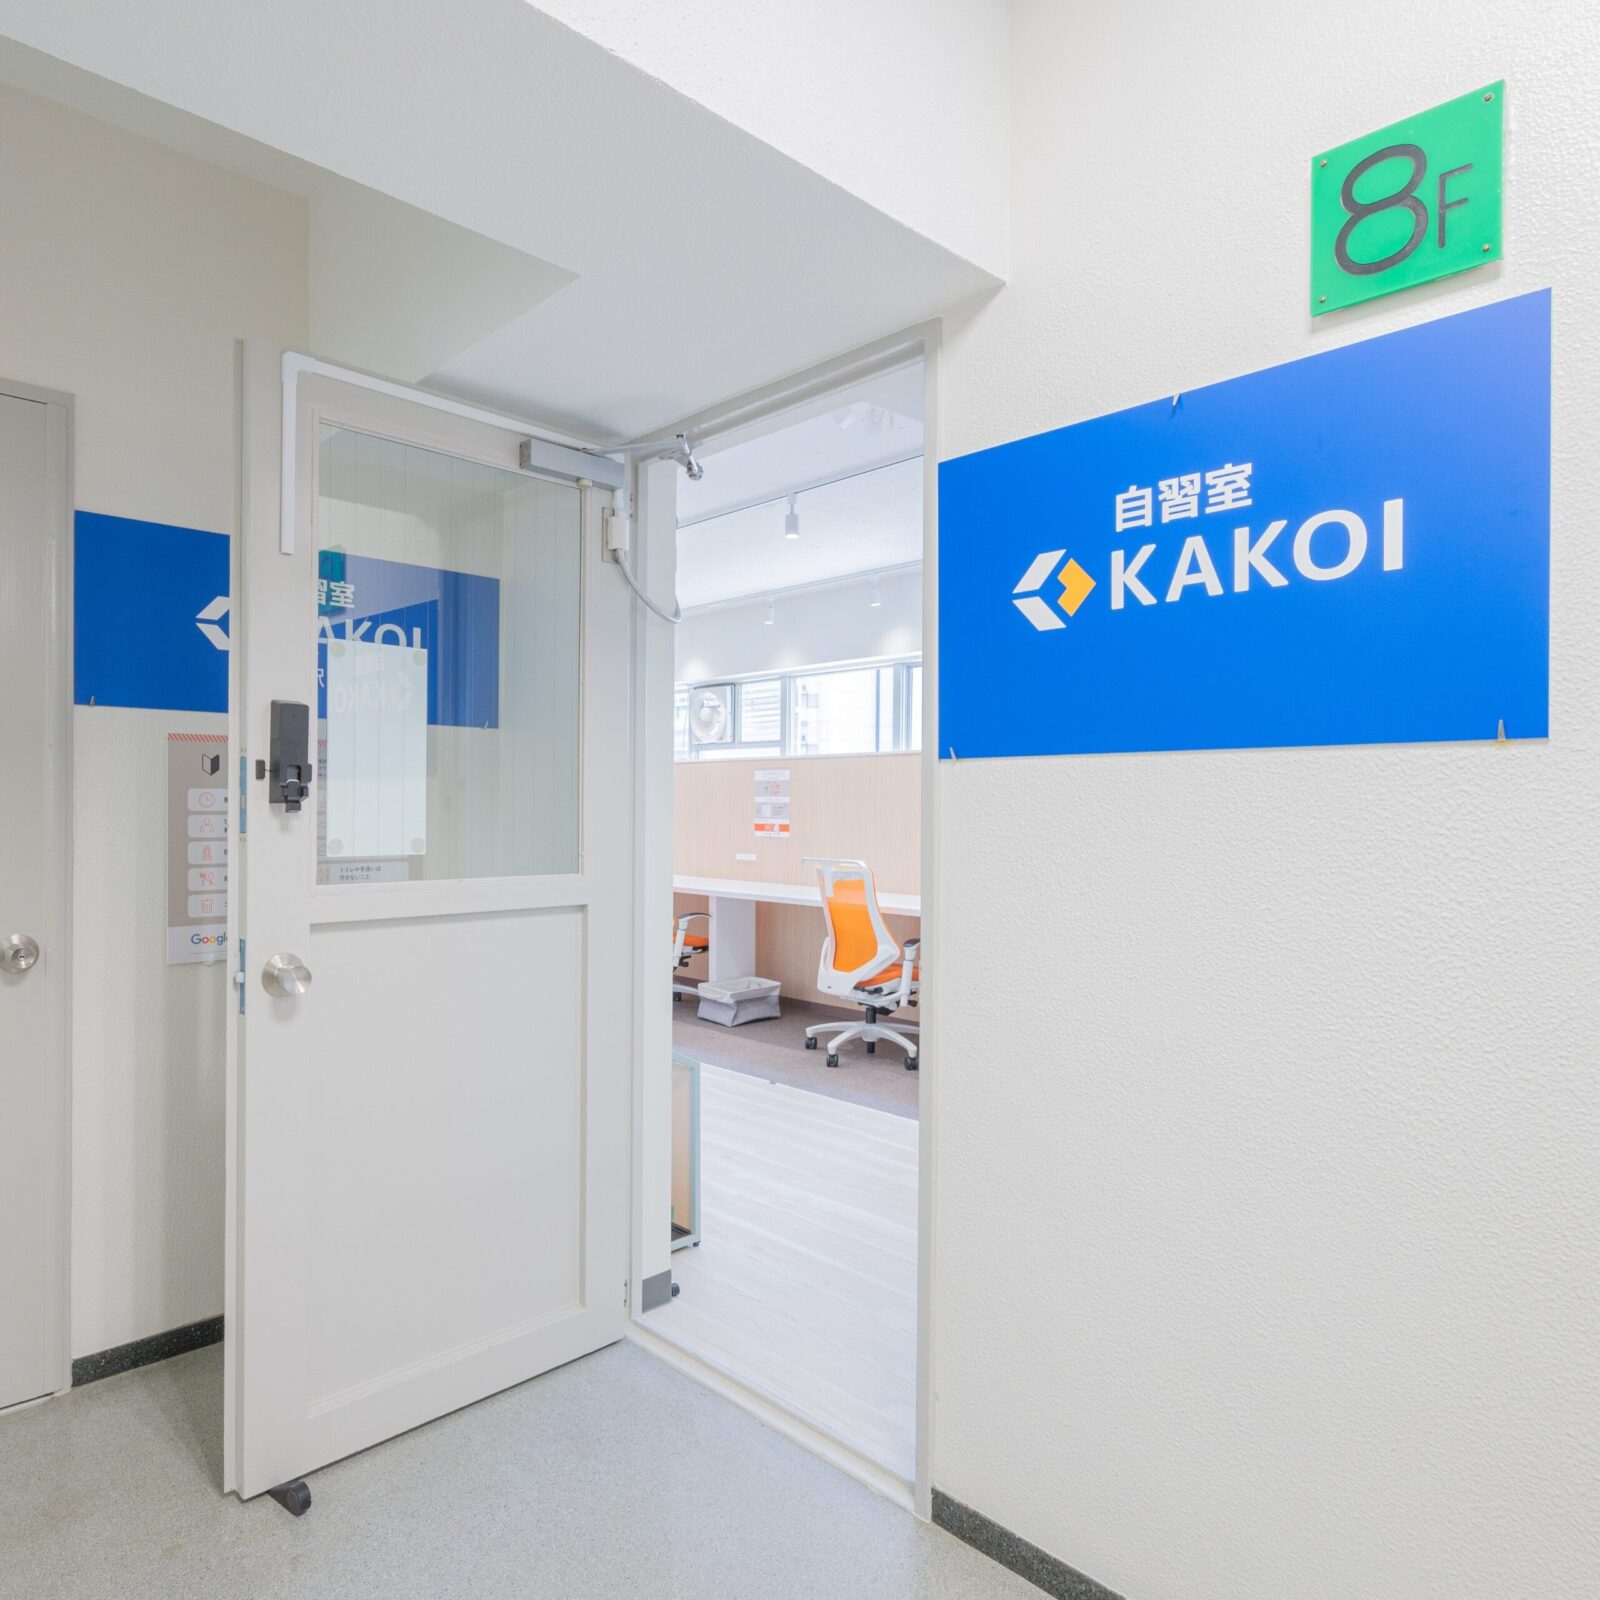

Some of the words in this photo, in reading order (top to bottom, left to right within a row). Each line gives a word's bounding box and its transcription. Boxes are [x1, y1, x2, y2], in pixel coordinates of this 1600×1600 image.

[1115, 462, 1252, 532] 自習室
[1111, 498, 1404, 610] KAKOI
[190, 932, 228, 946] Googl
